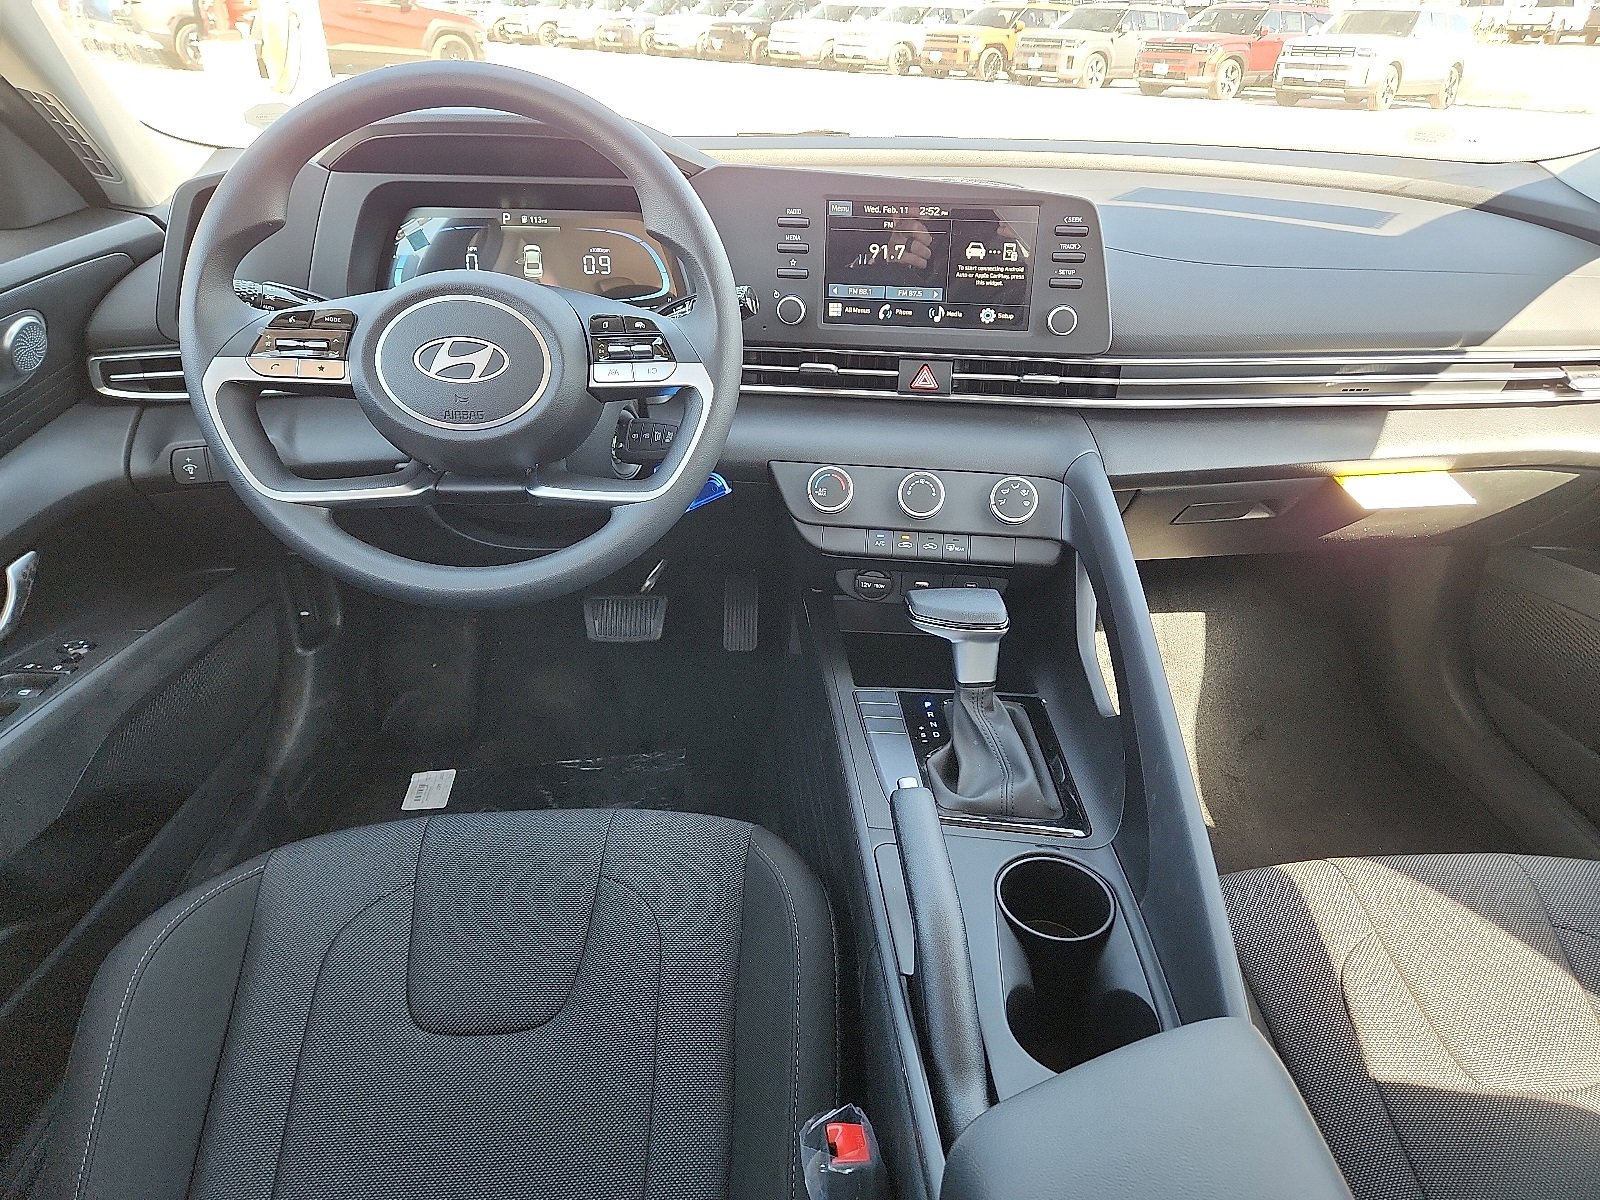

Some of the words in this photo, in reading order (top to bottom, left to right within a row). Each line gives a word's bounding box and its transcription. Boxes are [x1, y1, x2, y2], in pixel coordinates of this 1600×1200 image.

[831, 204, 850, 213] Menu
[863, 205, 881, 214] Wed.
[882, 206, 898, 214] Feb.
[899, 206, 909, 214] 11
[919, 206, 940, 216] 2:52
[502, 212, 511, 225] P
[869, 243, 906, 260] 91.7
[582, 254, 612, 275] 0.9
[895, 308, 913, 316] Phone
[997, 312, 1015, 320] Setup
[444, 410, 485, 420] AIRBAG
